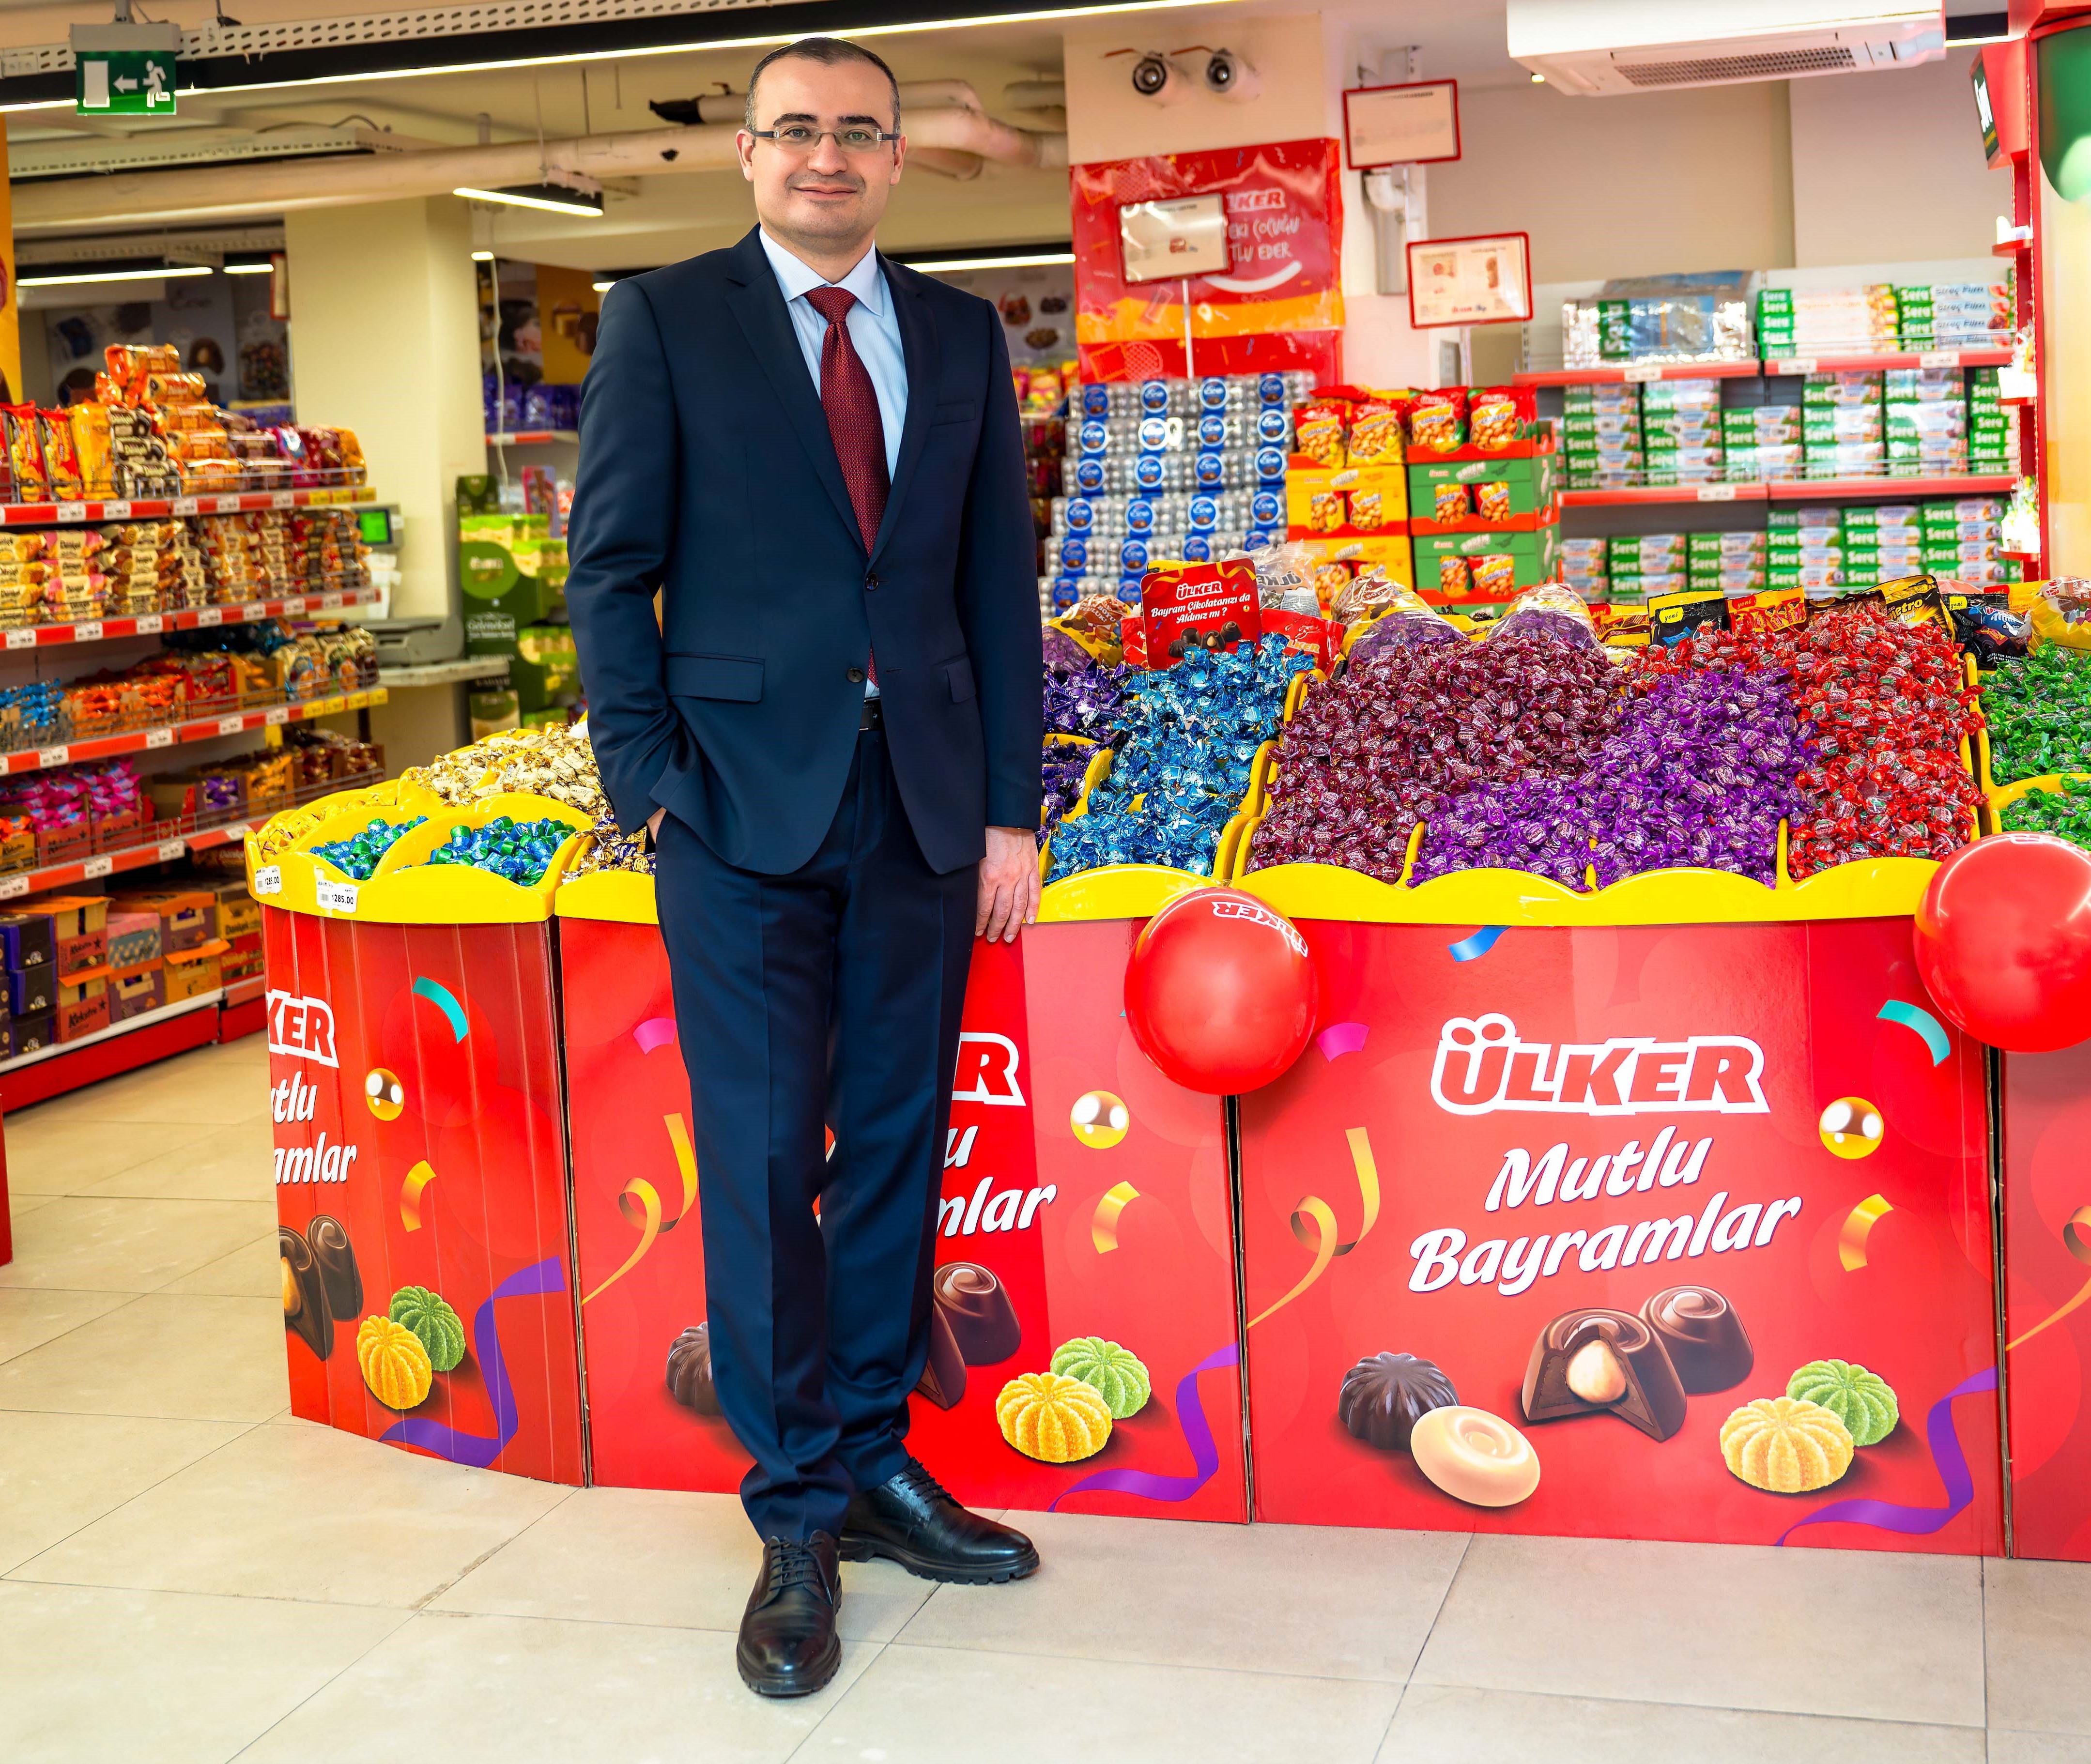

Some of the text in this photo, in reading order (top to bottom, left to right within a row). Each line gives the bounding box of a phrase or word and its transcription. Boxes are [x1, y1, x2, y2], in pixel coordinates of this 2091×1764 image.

[1901, 290, 1929, 302] Sera
[1902, 306, 1931, 318] Sera
[1764, 316, 1790, 327] Sera
[1903, 322, 1931, 334] Sera
[1973, 384, 2000, 397] Sera
[1977, 416, 2003, 428] Sera
[1974, 432, 2000, 444] Sera
[1768, 511, 1796, 524] Sera
[1846, 513, 1873, 525] Sera
[1924, 508, 1953, 522] Sera
[1768, 531, 1796, 546] Sera
[1846, 532, 1874, 546] Sera
[1926, 527, 1954, 540] Sera
[1769, 551, 1796, 565] Sera
[1847, 551, 1875, 564] Sera
[1927, 547, 1955, 561] Sera
[1769, 570, 1796, 584] Sera
[1847, 569, 1874, 583] Sera
[1176, 581, 1223, 600] ÜLKER
[1151, 593, 1251, 618] Bayram Çikolatanızı da
[1737, 598, 1752, 607] yeni
[1176, 607, 1228, 624] Aldınız mı ?
[1664, 611, 1679, 621] yeni
[1288, 638, 1321, 654] LKER
[1211, 901, 1308, 958] ÜLKER
[1430, 1012, 1770, 1116] ÜLKER
[1484, 1126, 1714, 1212] Mutlu
[1408, 1192, 1802, 1297] Bayramlar
